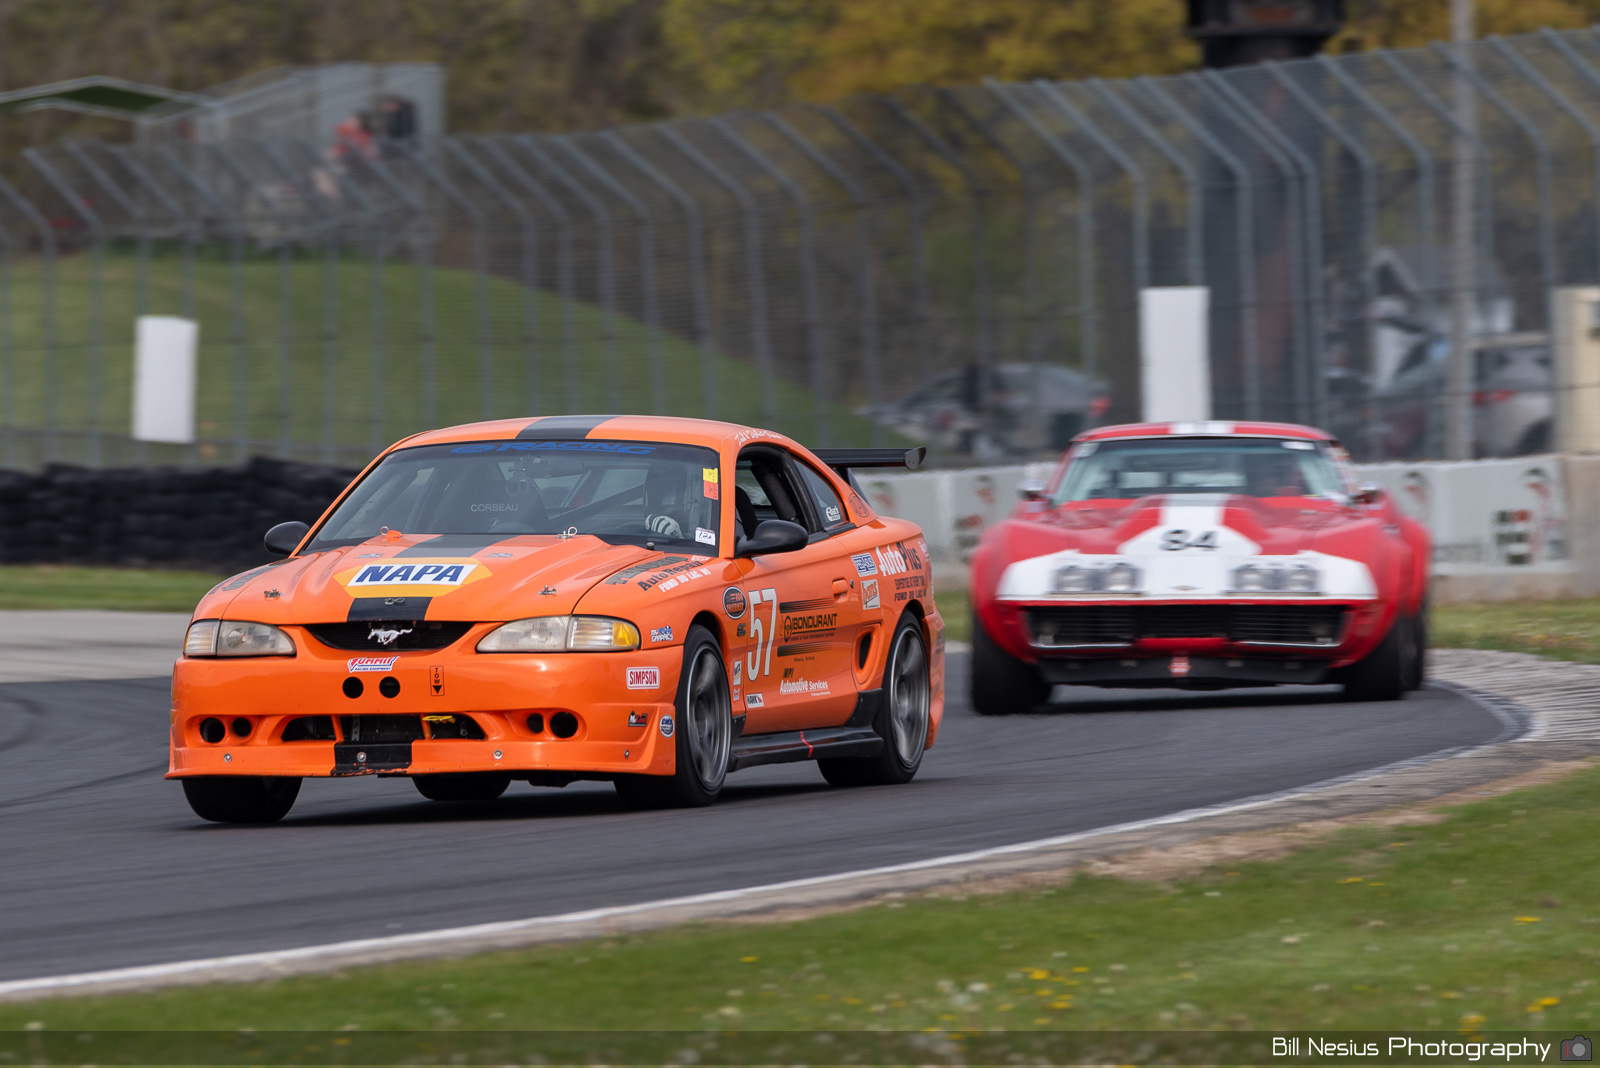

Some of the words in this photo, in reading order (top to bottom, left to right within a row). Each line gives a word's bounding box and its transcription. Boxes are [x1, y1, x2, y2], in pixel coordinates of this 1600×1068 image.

[496, 442, 656, 455] RACING
[470, 503, 519, 512] CORBEAU
[1161, 529, 1221, 551] 84
[355, 565, 465, 583] NAPA
[658, 578, 679, 593] FOND
[676, 574, 689, 584] DU
[792, 613, 838, 630] BONDURANT
[747, 587, 778, 682] 57
[629, 671, 657, 685] SIMPSON
[780, 677, 808, 695] Automotive
[809, 680, 828, 690] Services
